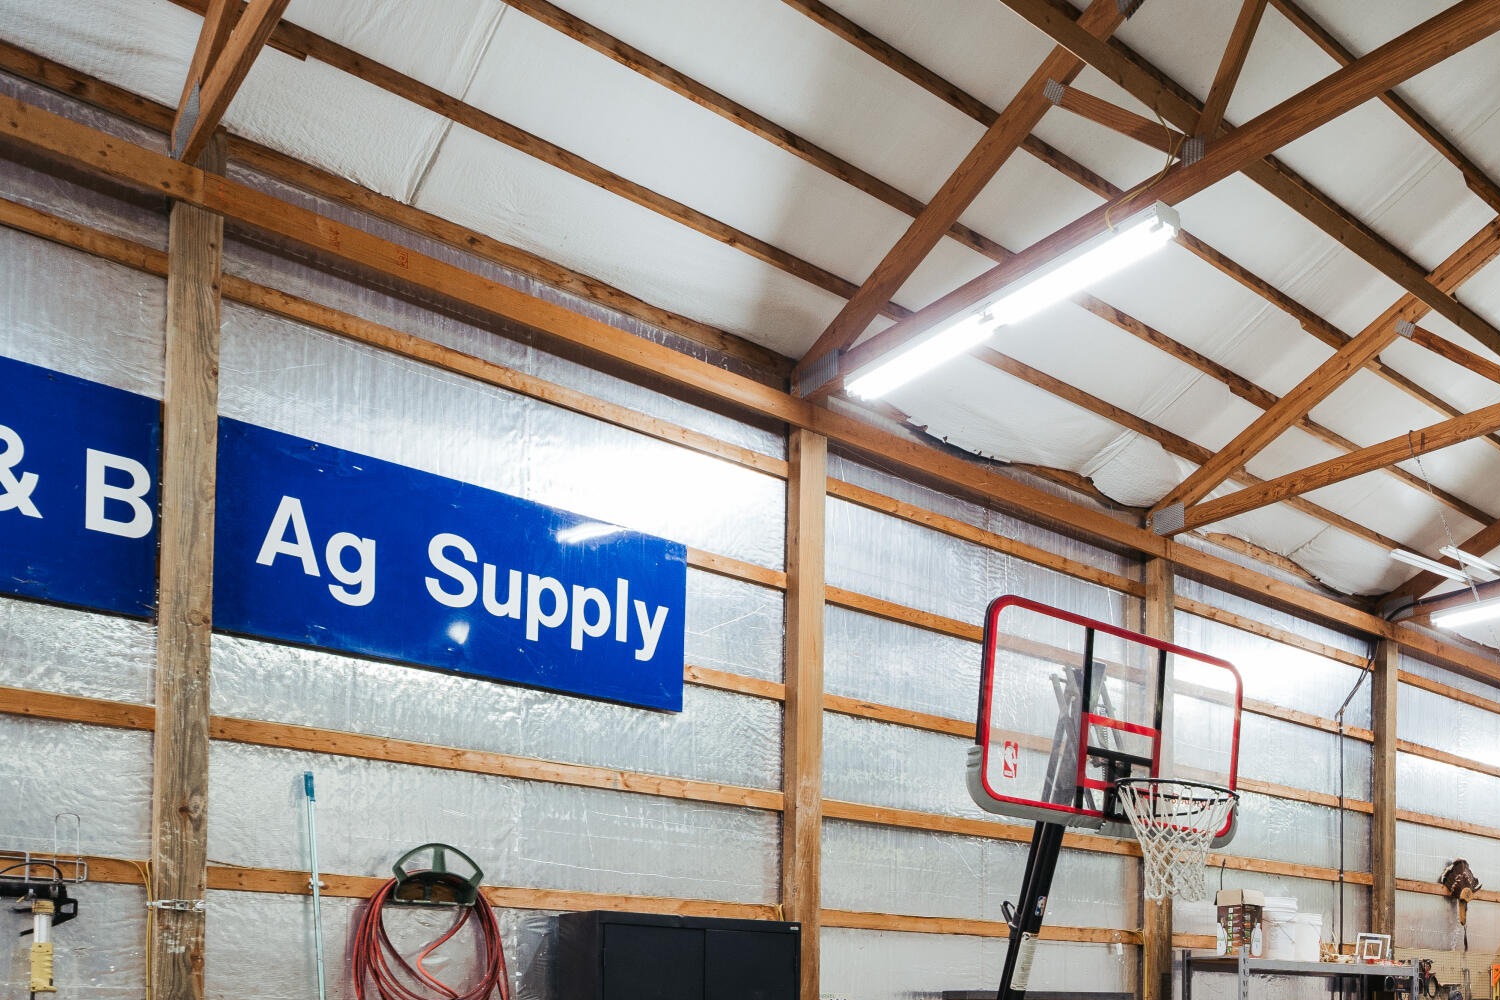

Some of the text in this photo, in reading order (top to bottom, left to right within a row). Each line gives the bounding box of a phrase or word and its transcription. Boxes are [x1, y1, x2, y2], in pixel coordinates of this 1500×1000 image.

[85, 447, 153, 539] B
[256, 495, 376, 607] Ag
[424, 533, 669, 661] Supply
